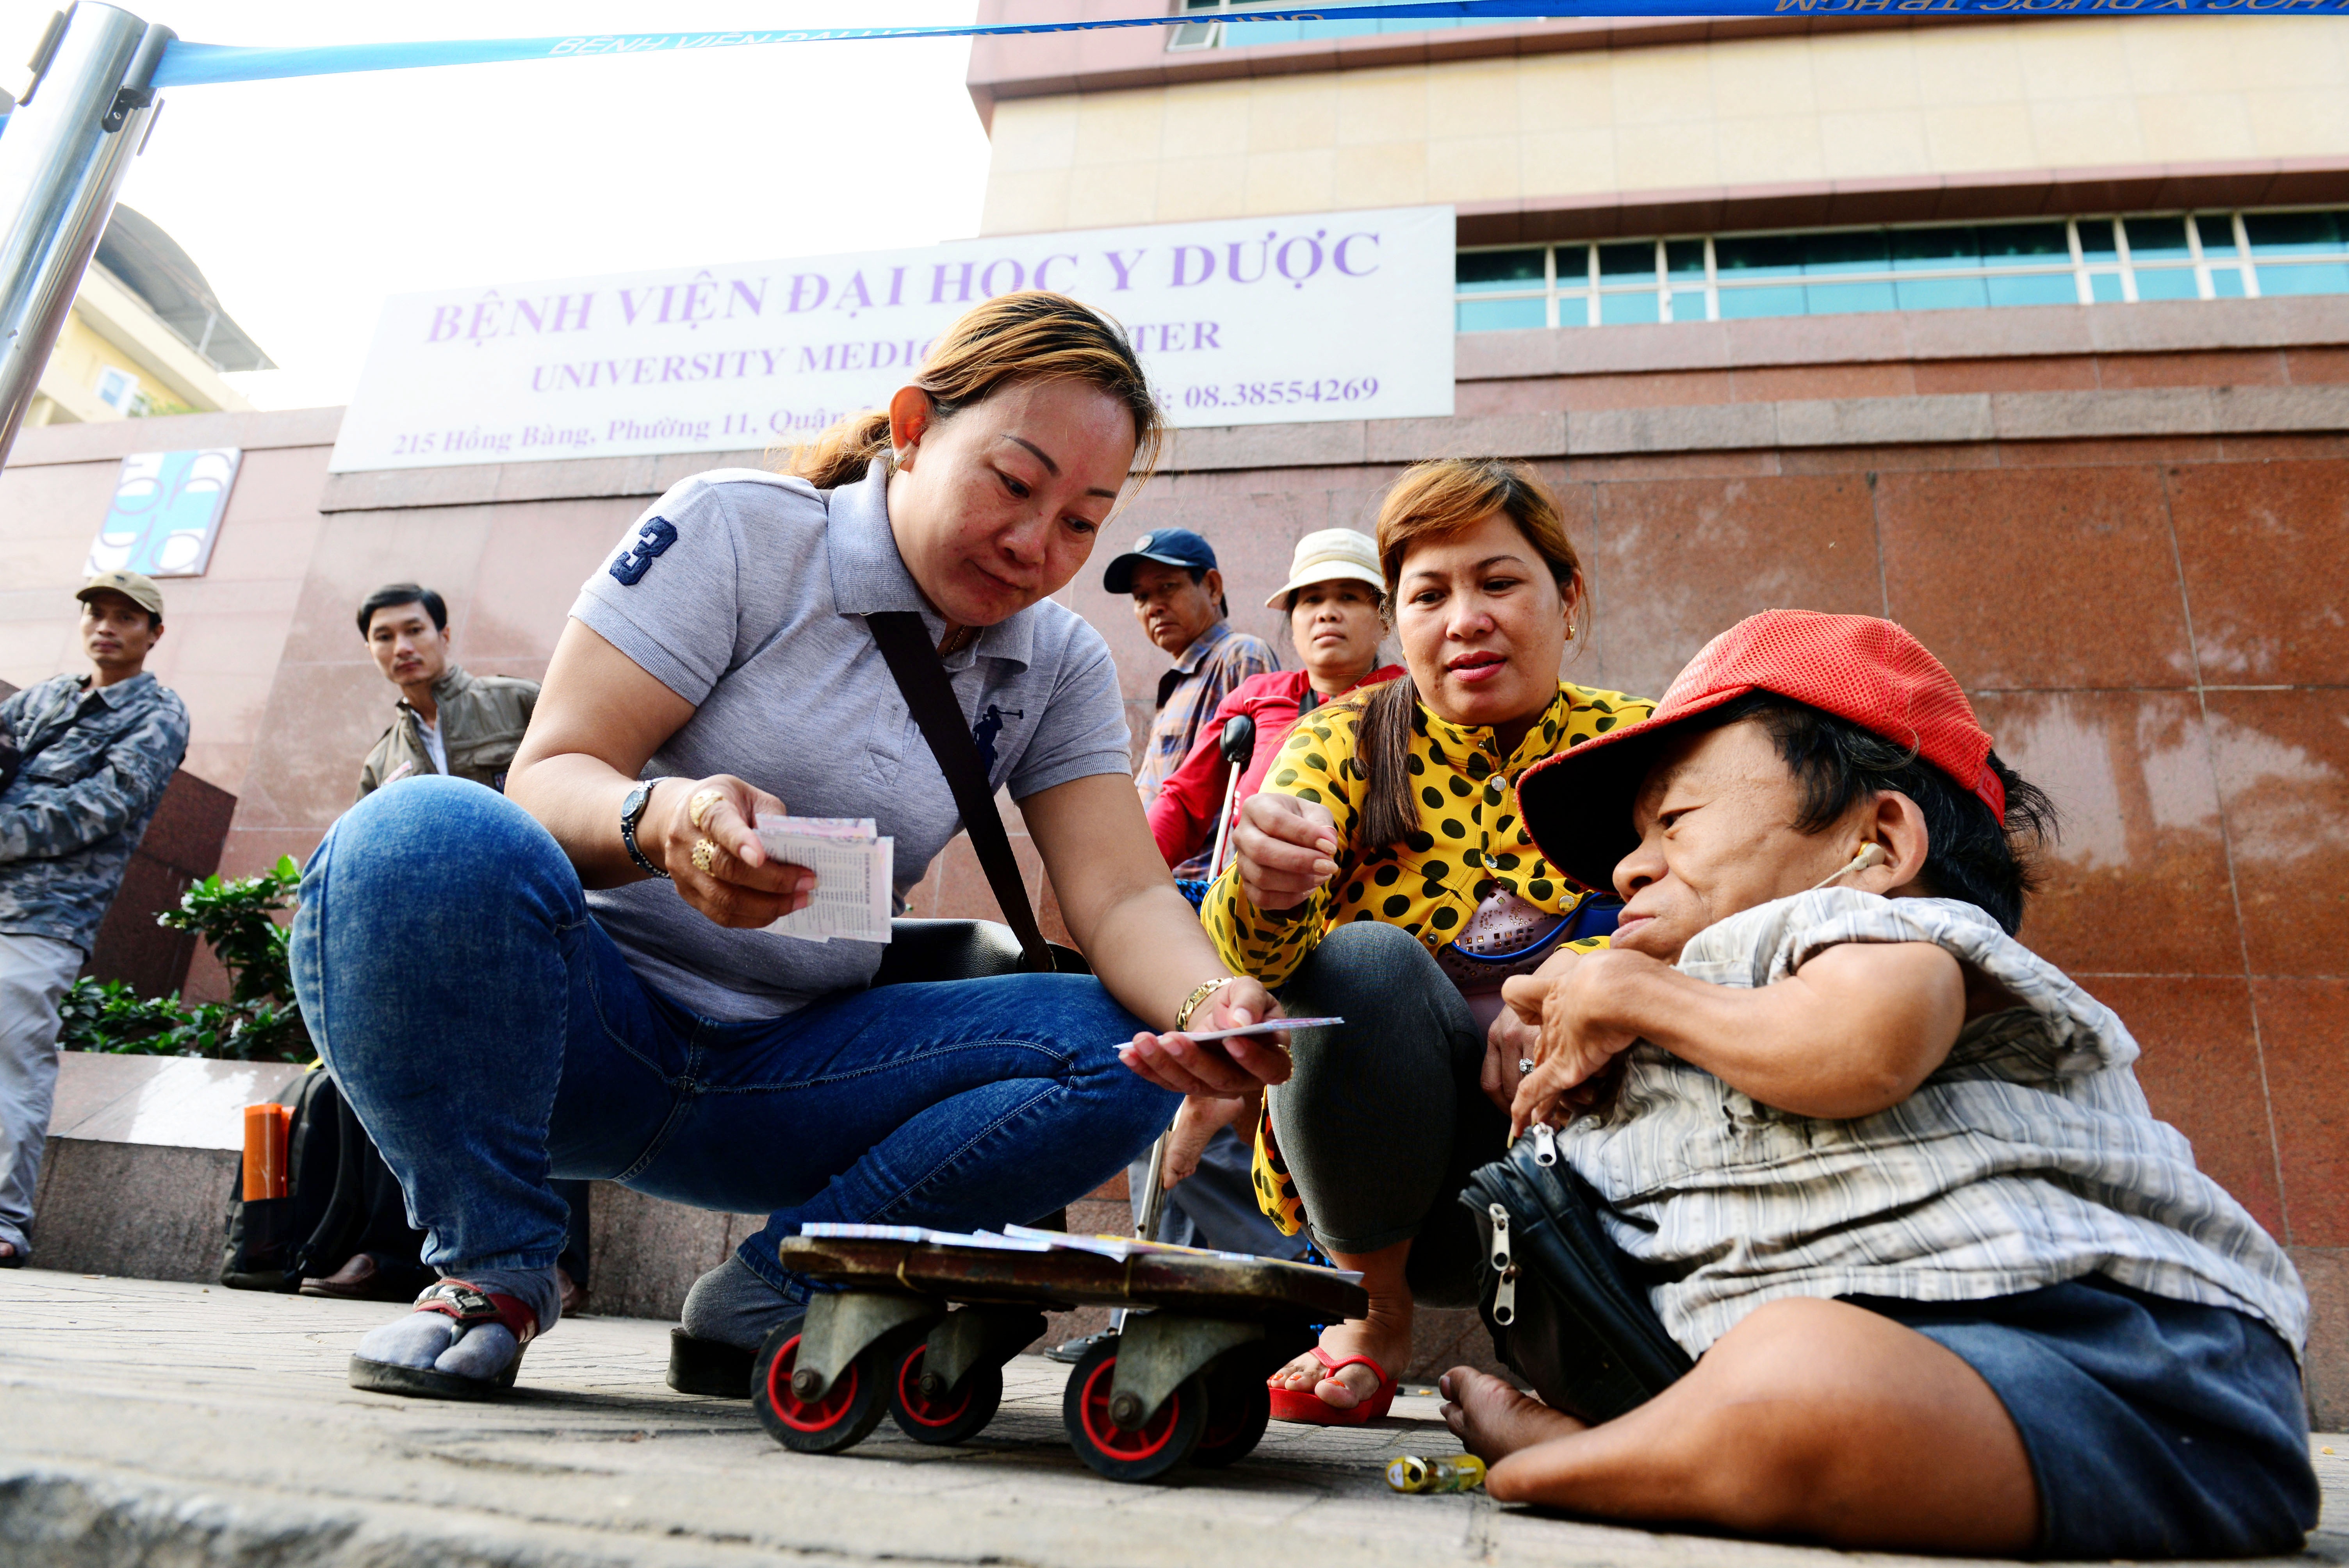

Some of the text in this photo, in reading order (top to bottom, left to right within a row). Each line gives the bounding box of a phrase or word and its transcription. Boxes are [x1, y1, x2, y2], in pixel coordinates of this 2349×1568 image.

[426, 290, 598, 347] BỆNH
[617, 268, 772, 330] VIỆN
[784, 266, 910, 318] ĐẠI
[1103, 248, 1146, 292] Y
[1167, 229, 1381, 289] DƯỢC
[531, 320, 1222, 392] UNIVERSITY MEDI TER
[391, 432, 437, 456] 215
[442, 426, 513, 454] Hồng
[606, 416, 711, 442] Phường
[722, 412, 757, 435] 11,
[1184, 376, 1379, 409] 08.38554269
[609, 515, 678, 586] 3
